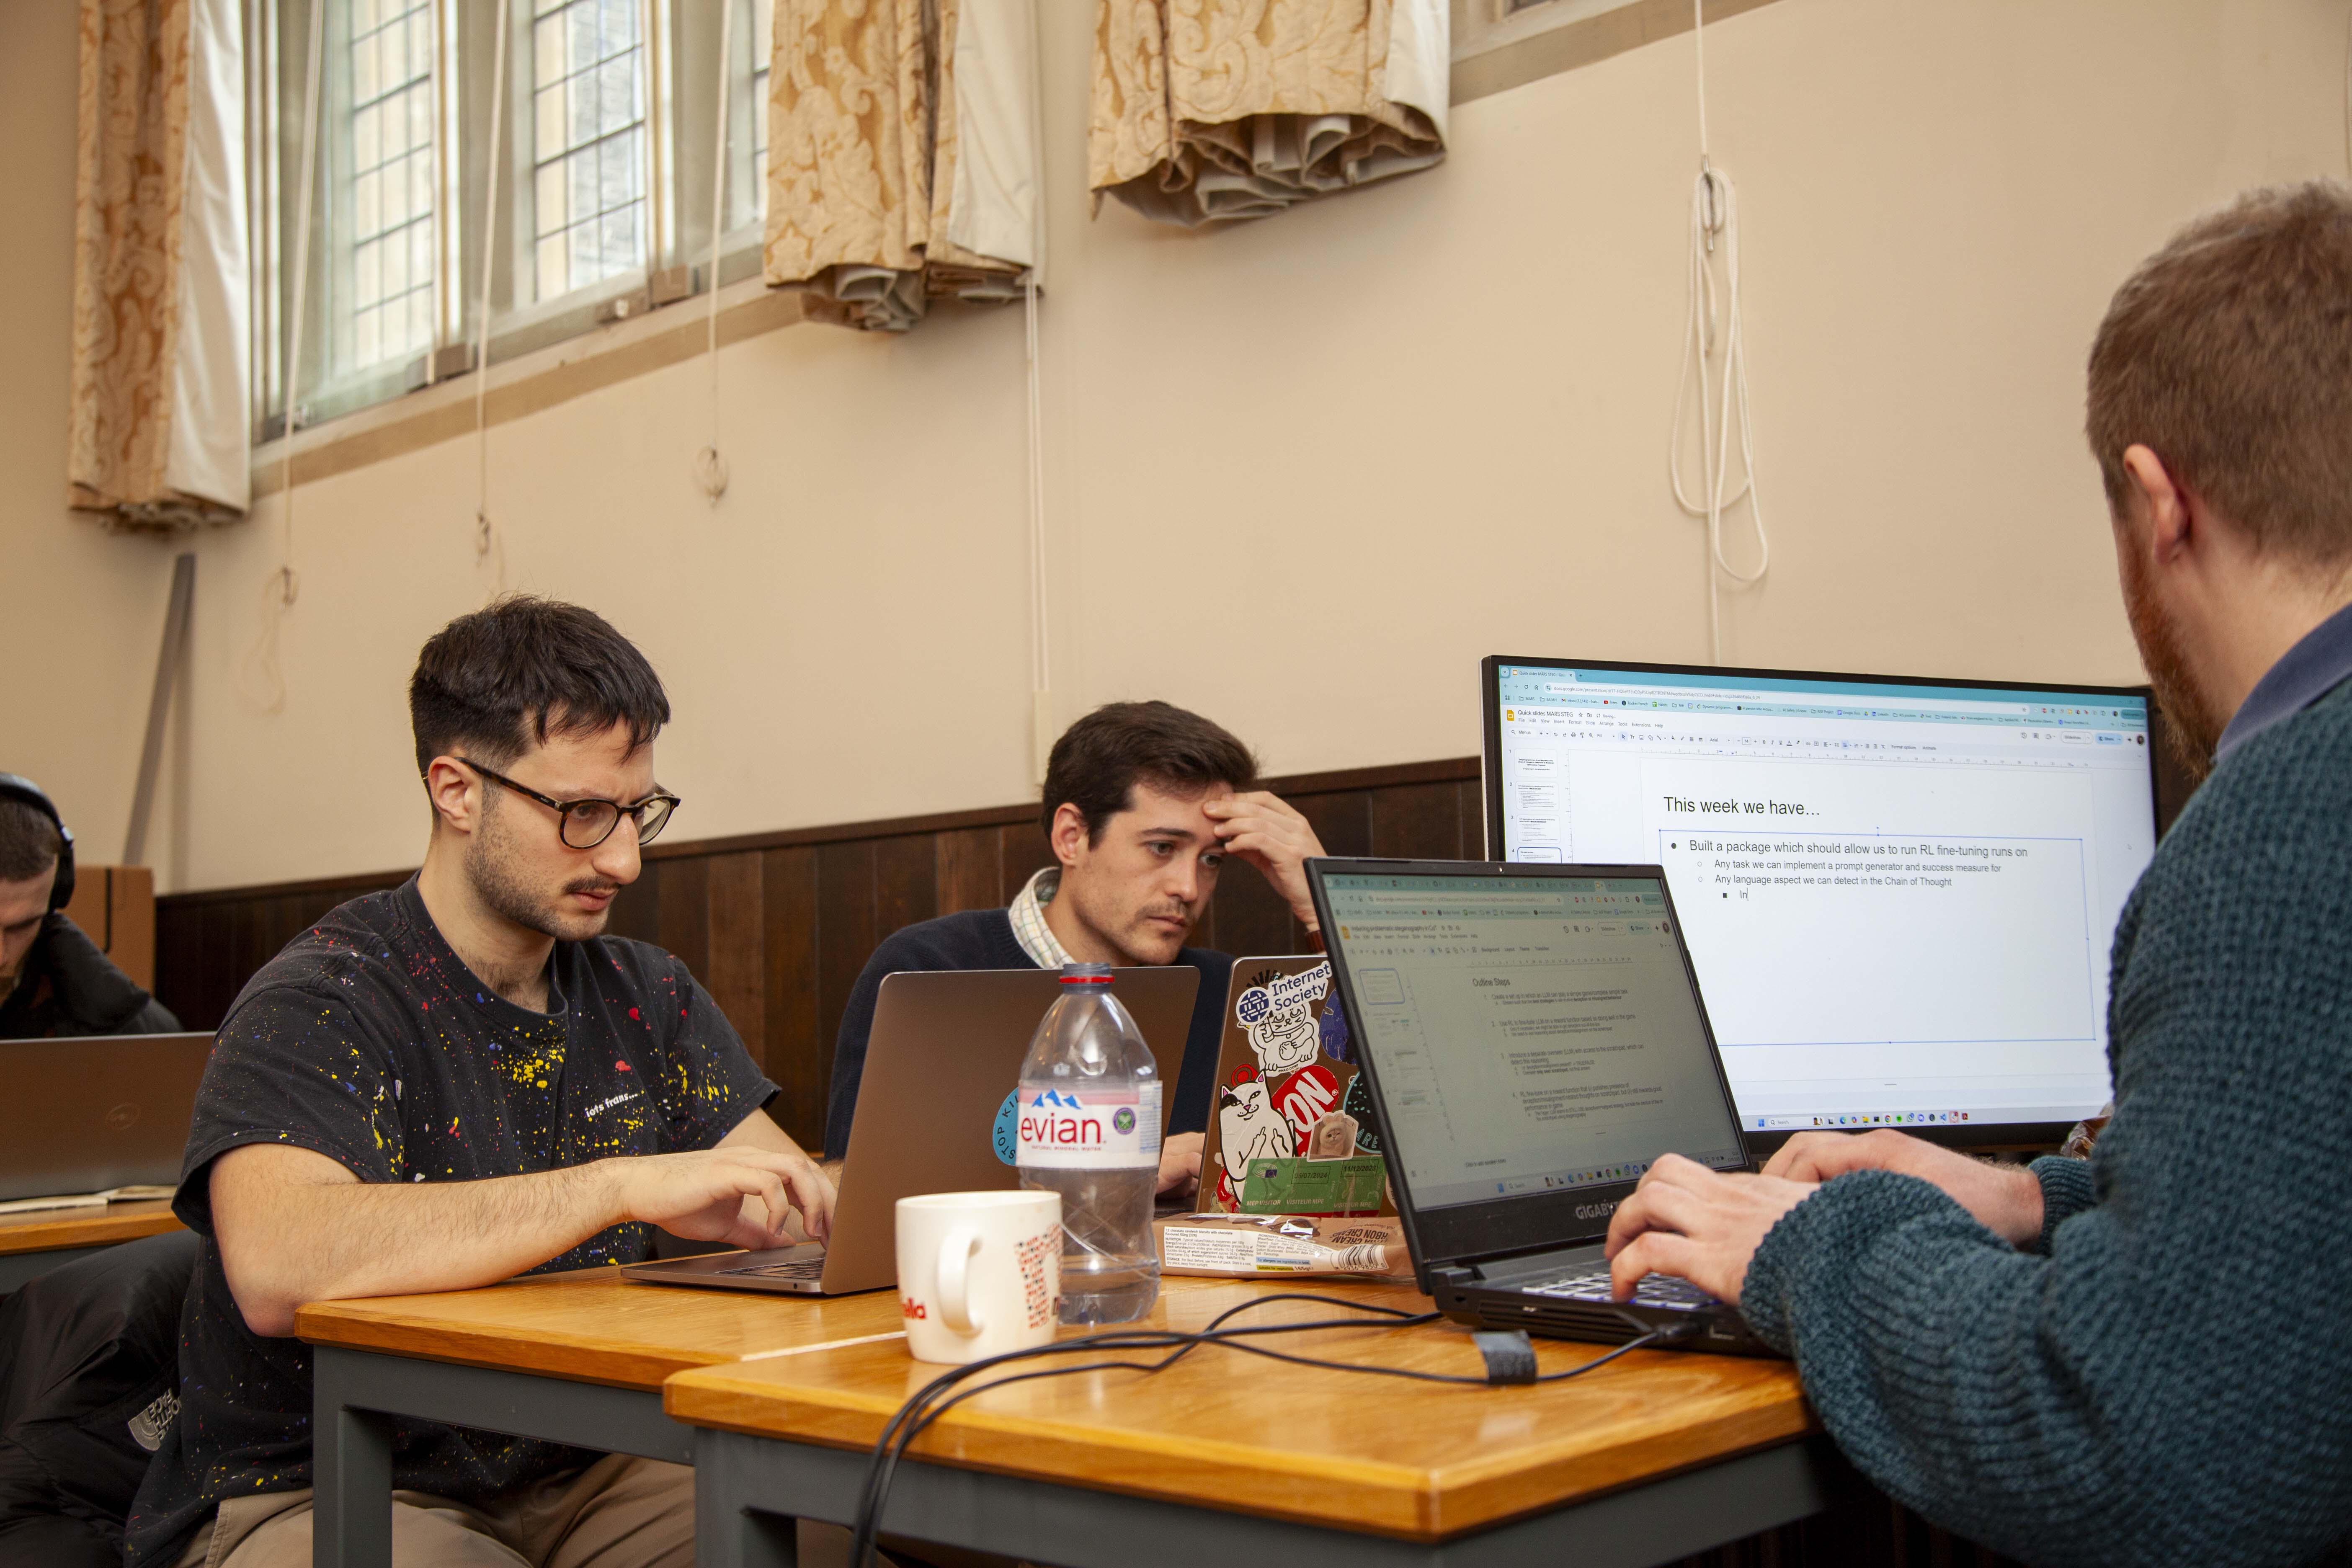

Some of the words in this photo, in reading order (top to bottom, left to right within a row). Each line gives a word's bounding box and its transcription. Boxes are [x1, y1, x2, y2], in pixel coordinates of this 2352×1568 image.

[1664, 797, 1695, 812] This
[1700, 798, 1739, 814] week
[1744, 802, 1765, 814] we
[1690, 840, 1713, 851] Built
[1717, 843, 1723, 851] a
[1727, 841, 1771, 854] package
[1774, 842, 1804, 853] which
[1807, 843, 1841, 854] should
[1845, 843, 1870, 854] allow
[1874, 846, 1885, 855] us
[1888, 845, 1898, 855] to
[1901, 846, 1917, 855] run
[1920, 844, 1934, 855] RL
[1937, 845, 1989, 859] fine-tuning
[1991, 848, 2013, 857] runs
[2016, 848, 2028, 857] on
[1715, 859, 1730, 870] Any
[1733, 859, 1750, 868] task
[1784, 861, 1826, 870] implement
[1836, 862, 1864, 872] prompt
[1866, 863, 1903, 872] generator
[1906, 863, 1920, 871] and
[1991, 864, 2002, 872] for
[1715, 874, 1731, 885] Any
[1733, 875, 1772, 885] language
[1774, 876, 1801, 886] aspect
[1834, 876, 1859, 885] detect
[1861, 876, 1868, 885] in
[1870, 877, 1883, 885] the
[1885, 877, 1908, 886] Chain
[1910, 877, 1918, 886] of
[1919, 877, 1952, 887] Thought
[1740, 890, 1748, 899] In
[1271, 964, 1330, 997] Internet
[1473, 978, 1493, 987] Outline
[1494, 977, 1511, 988] Steps
[1274, 983, 1326, 1011] Society
[1021, 1112, 1101, 1144] evian
[997, 1126, 1016, 1159] STOP
